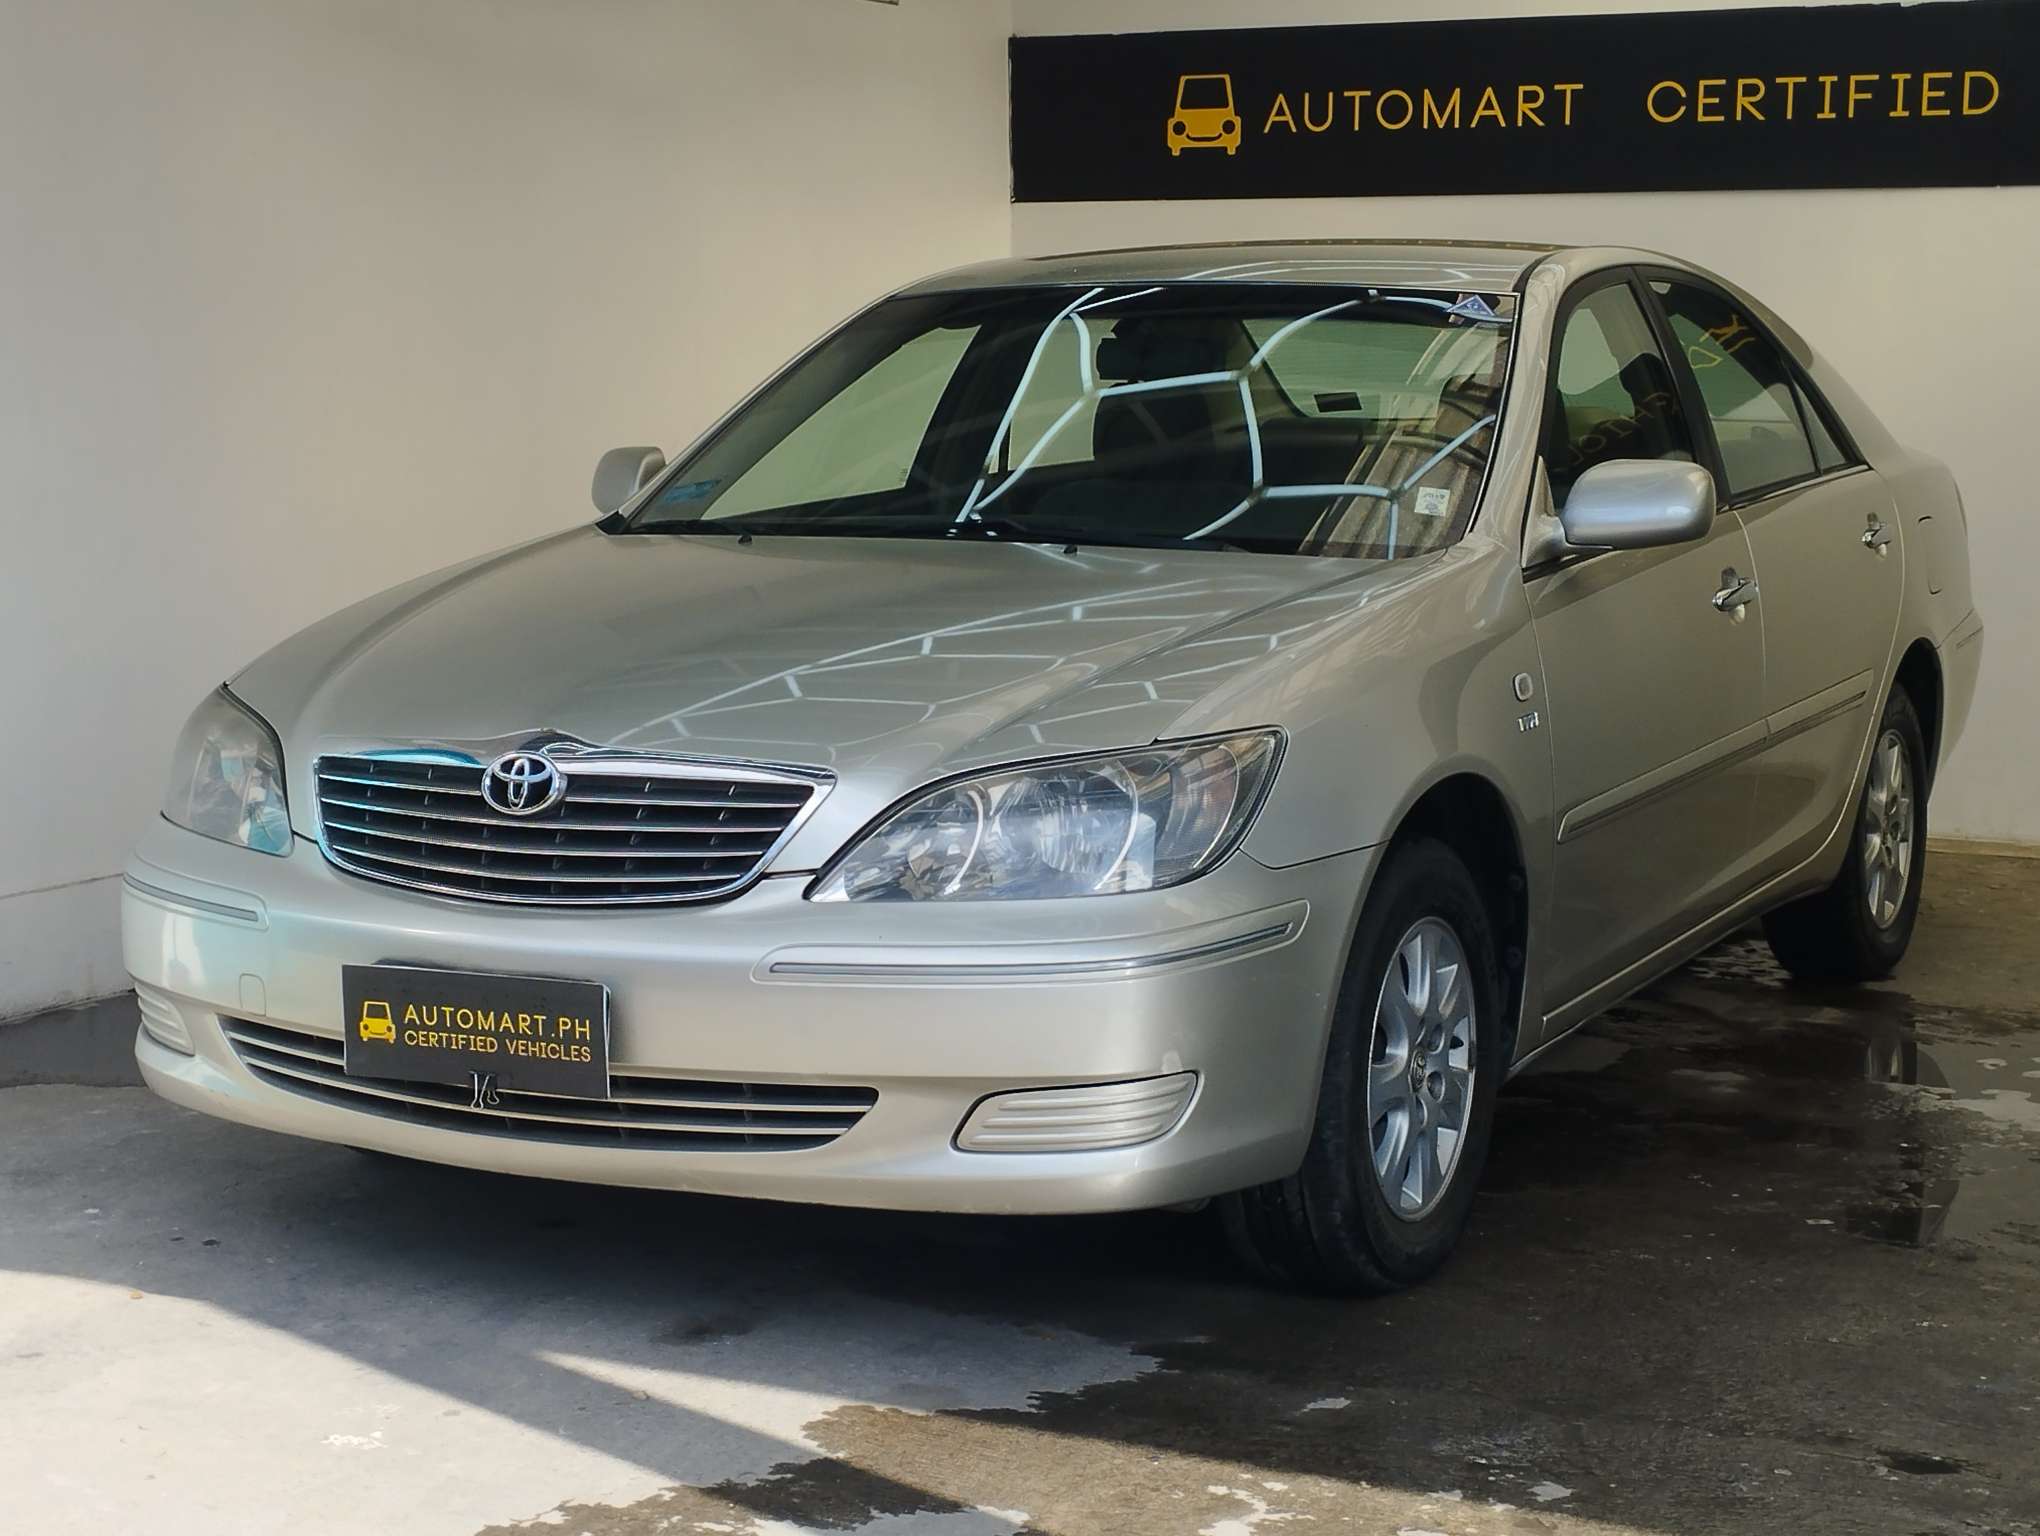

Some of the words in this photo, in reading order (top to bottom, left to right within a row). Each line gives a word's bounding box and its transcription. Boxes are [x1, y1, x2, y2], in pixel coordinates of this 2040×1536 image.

[1263, 82, 1584, 134] AUTOMART
[1646, 70, 2000, 124] CERTIFIED
[403, 1004, 593, 1041] AUTOMART.PH
[404, 1029, 498, 1055] CERTIFIED
[506, 1038, 593, 1063] VEHICLES
